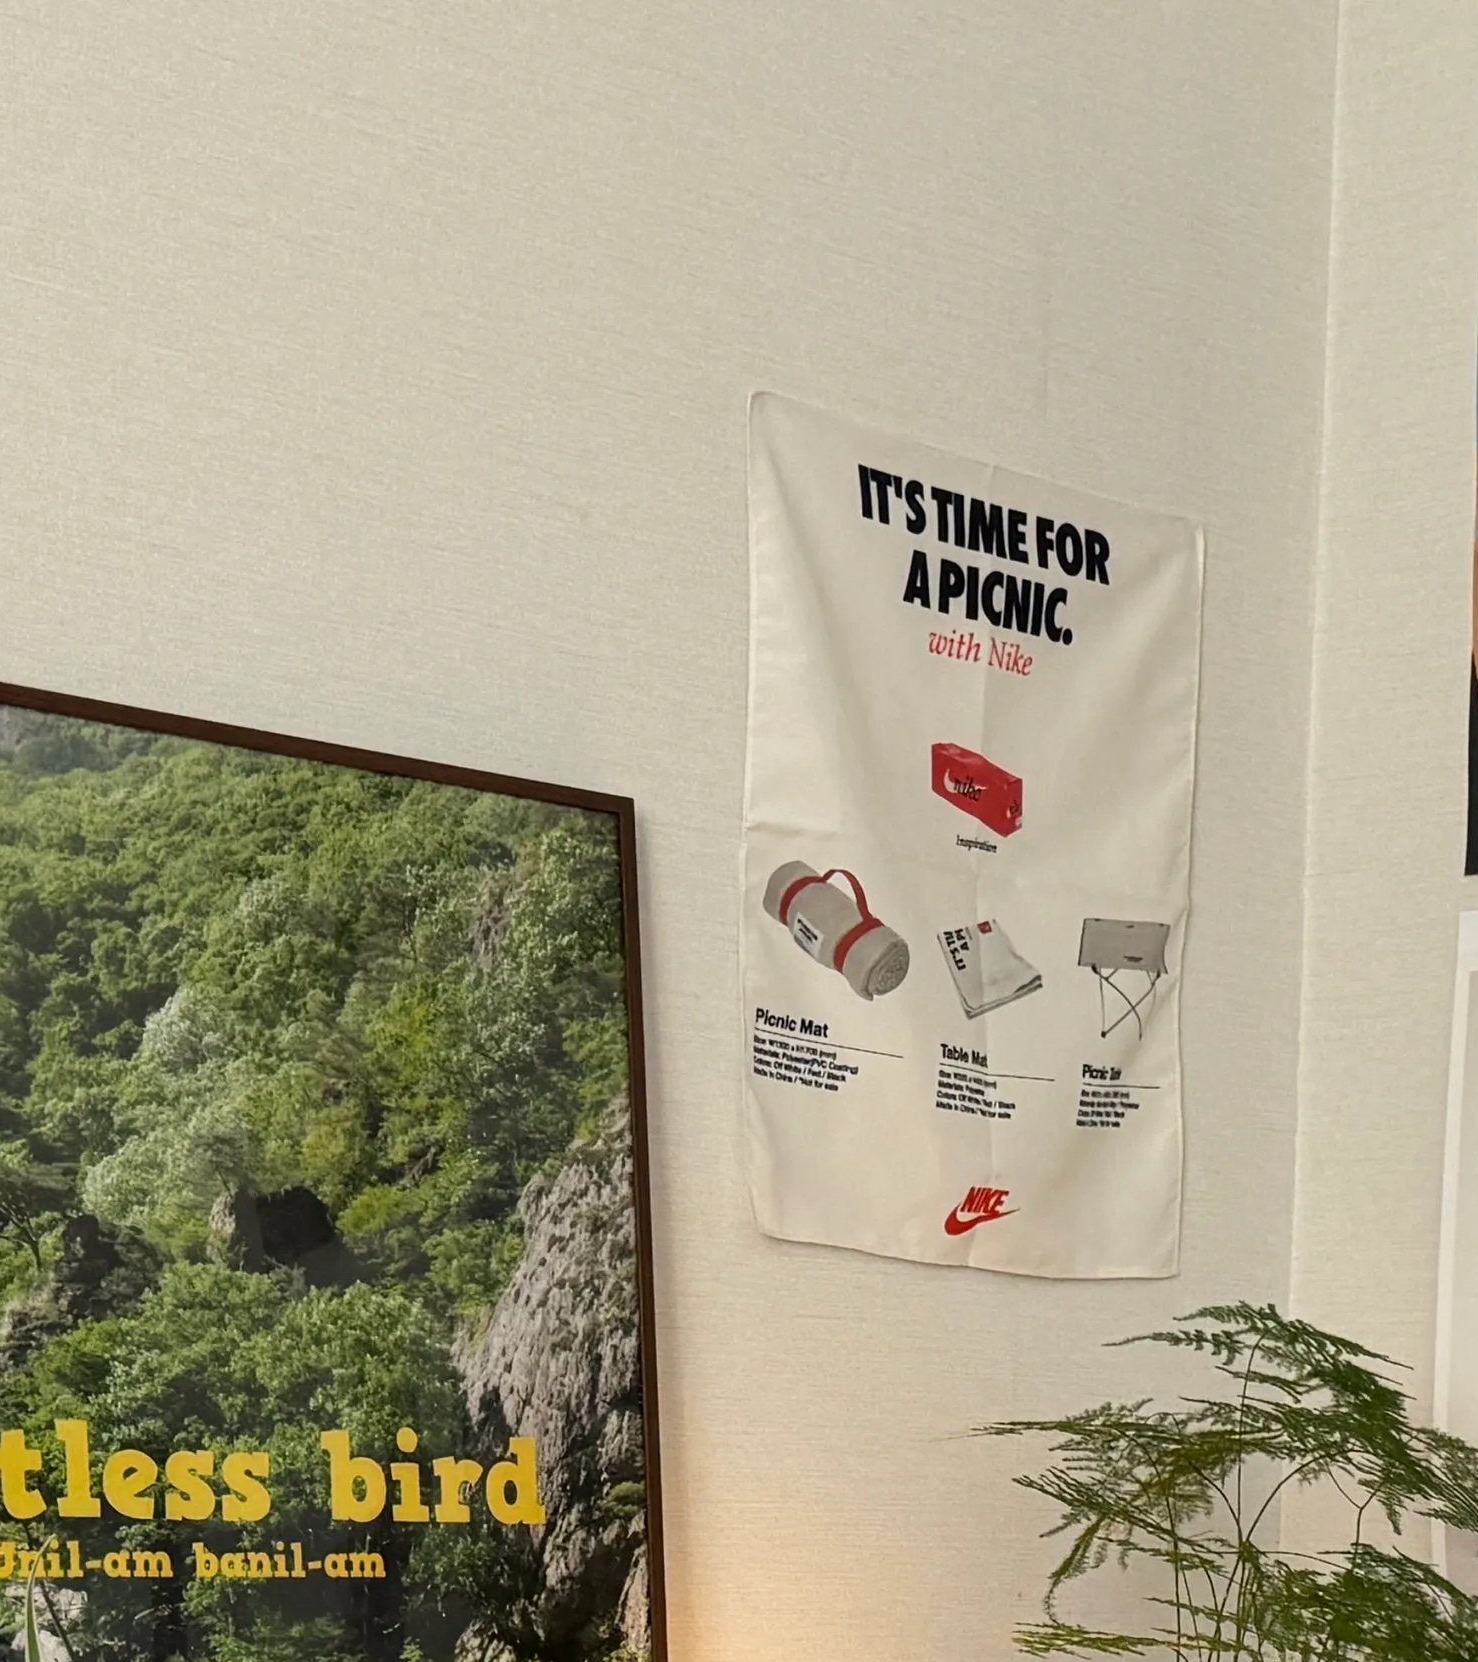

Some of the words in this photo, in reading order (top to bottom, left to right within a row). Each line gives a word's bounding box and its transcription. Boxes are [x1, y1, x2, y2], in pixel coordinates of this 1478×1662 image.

[858, 463, 925, 534] IT'S
[931, 486, 1028, 563] TIME
[1036, 515, 1110, 585] FOR
[903, 550, 931, 609] A
[938, 558, 1073, 645] PICNIC.
[928, 630, 981, 663] with
[987, 637, 1033, 676] Nike
[756, 1008, 797, 1031] Picnic
[800, 1018, 829, 1038] Mat
[960, 1186, 1010, 1215] NIKE
[321, 1427, 547, 1525] bird
[192, 1541, 386, 1580] banil-am
